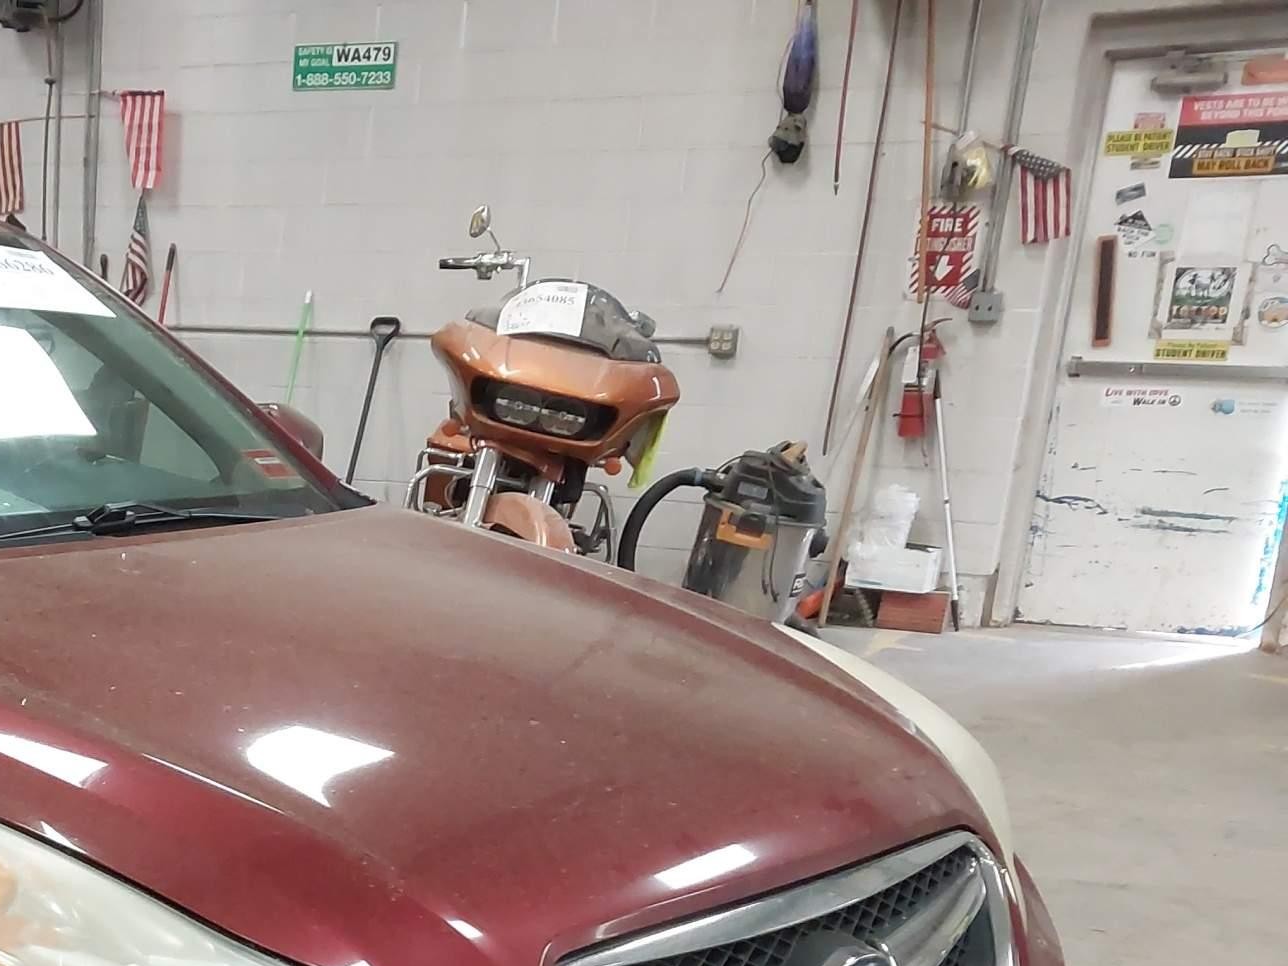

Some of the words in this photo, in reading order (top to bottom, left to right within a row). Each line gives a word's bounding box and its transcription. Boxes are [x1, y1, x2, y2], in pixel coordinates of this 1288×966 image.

[336, 46, 392, 63] WA479
[295, 71, 391, 86] 1-888-550-7233
[932, 217, 964, 233] FIRE
[1155, 348, 1193, 358] STUDENT
[1195, 348, 1226, 359] DRIVER
